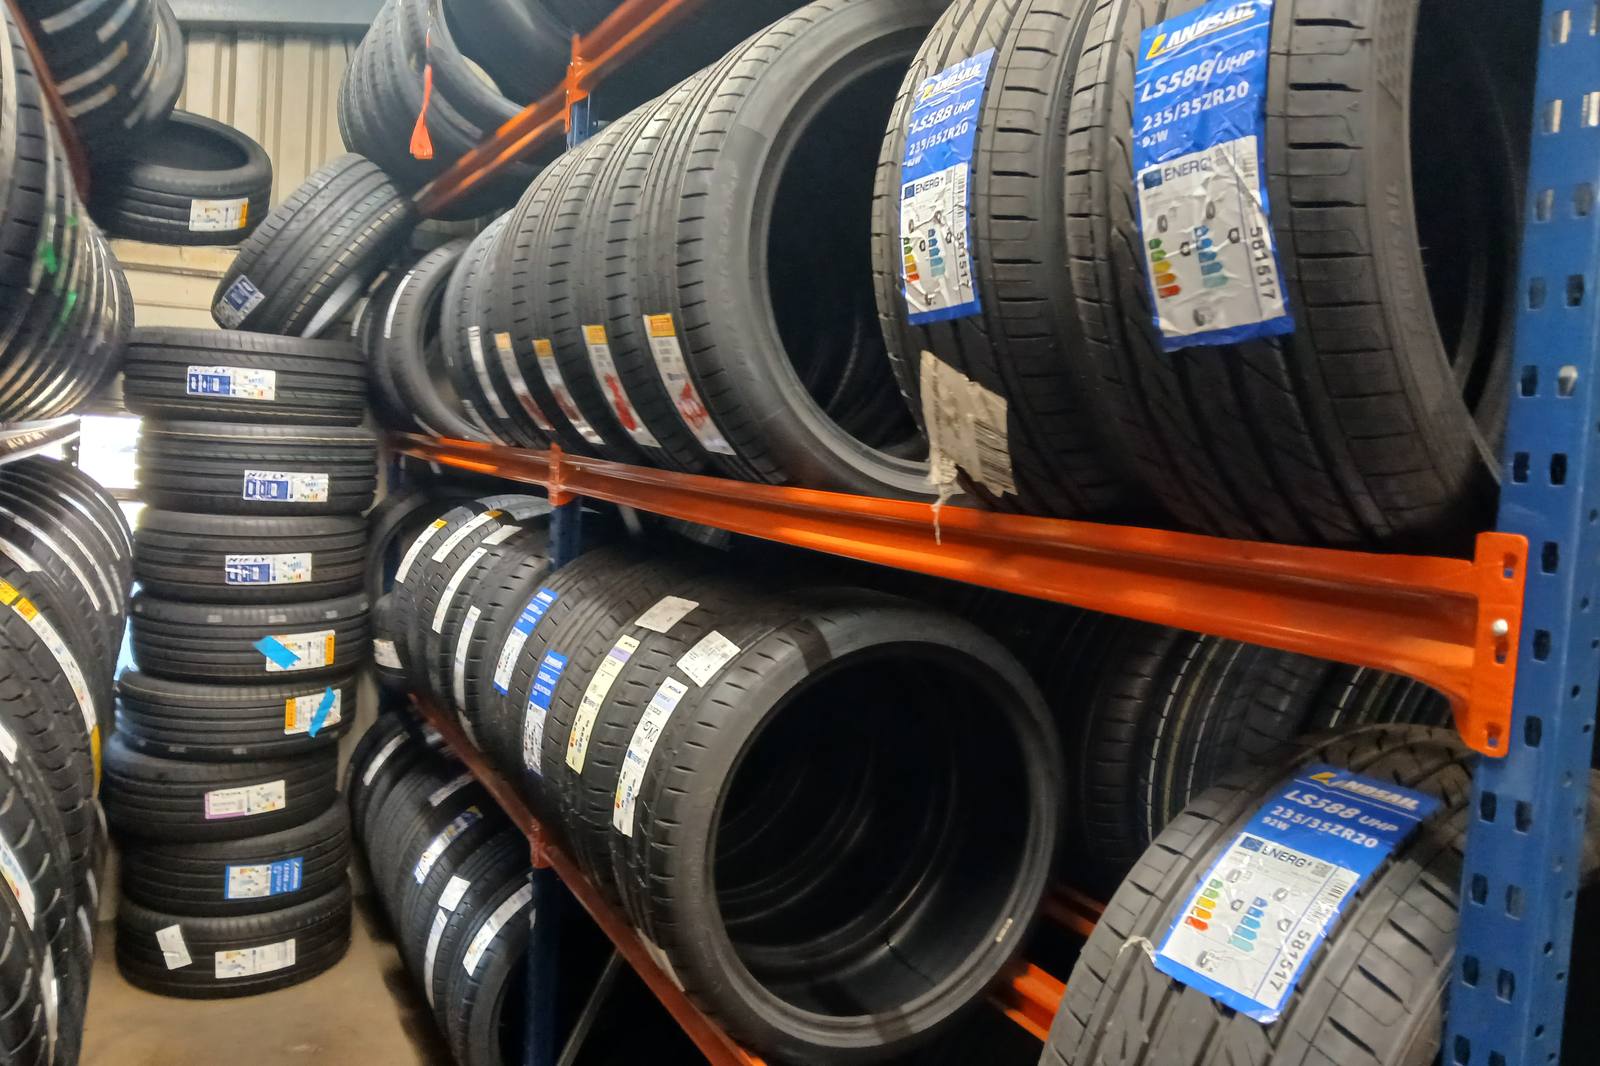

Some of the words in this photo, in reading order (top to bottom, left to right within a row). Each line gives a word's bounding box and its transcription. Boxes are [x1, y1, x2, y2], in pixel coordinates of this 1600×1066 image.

[1145, 6, 1257, 60] LANDSAIL
[1140, 58, 1215, 102] LS588
[1216, 50, 1255, 74] UHP
[953, 99, 976, 117] UHP
[1142, 81, 1250, 131] 235/35ZR20
[1142, 129, 1168, 148] 92W
[1250, 226, 1276, 300] 581517
[1262, 816, 1291, 831] 92W
[1271, 806, 1379, 848] 235/35ZR20
[1283, 790, 1362, 819] LS588
[1358, 815, 1399, 832] UHP
[1261, 846, 1307, 868] ENERG
[1269, 929, 1312, 992] 581517
